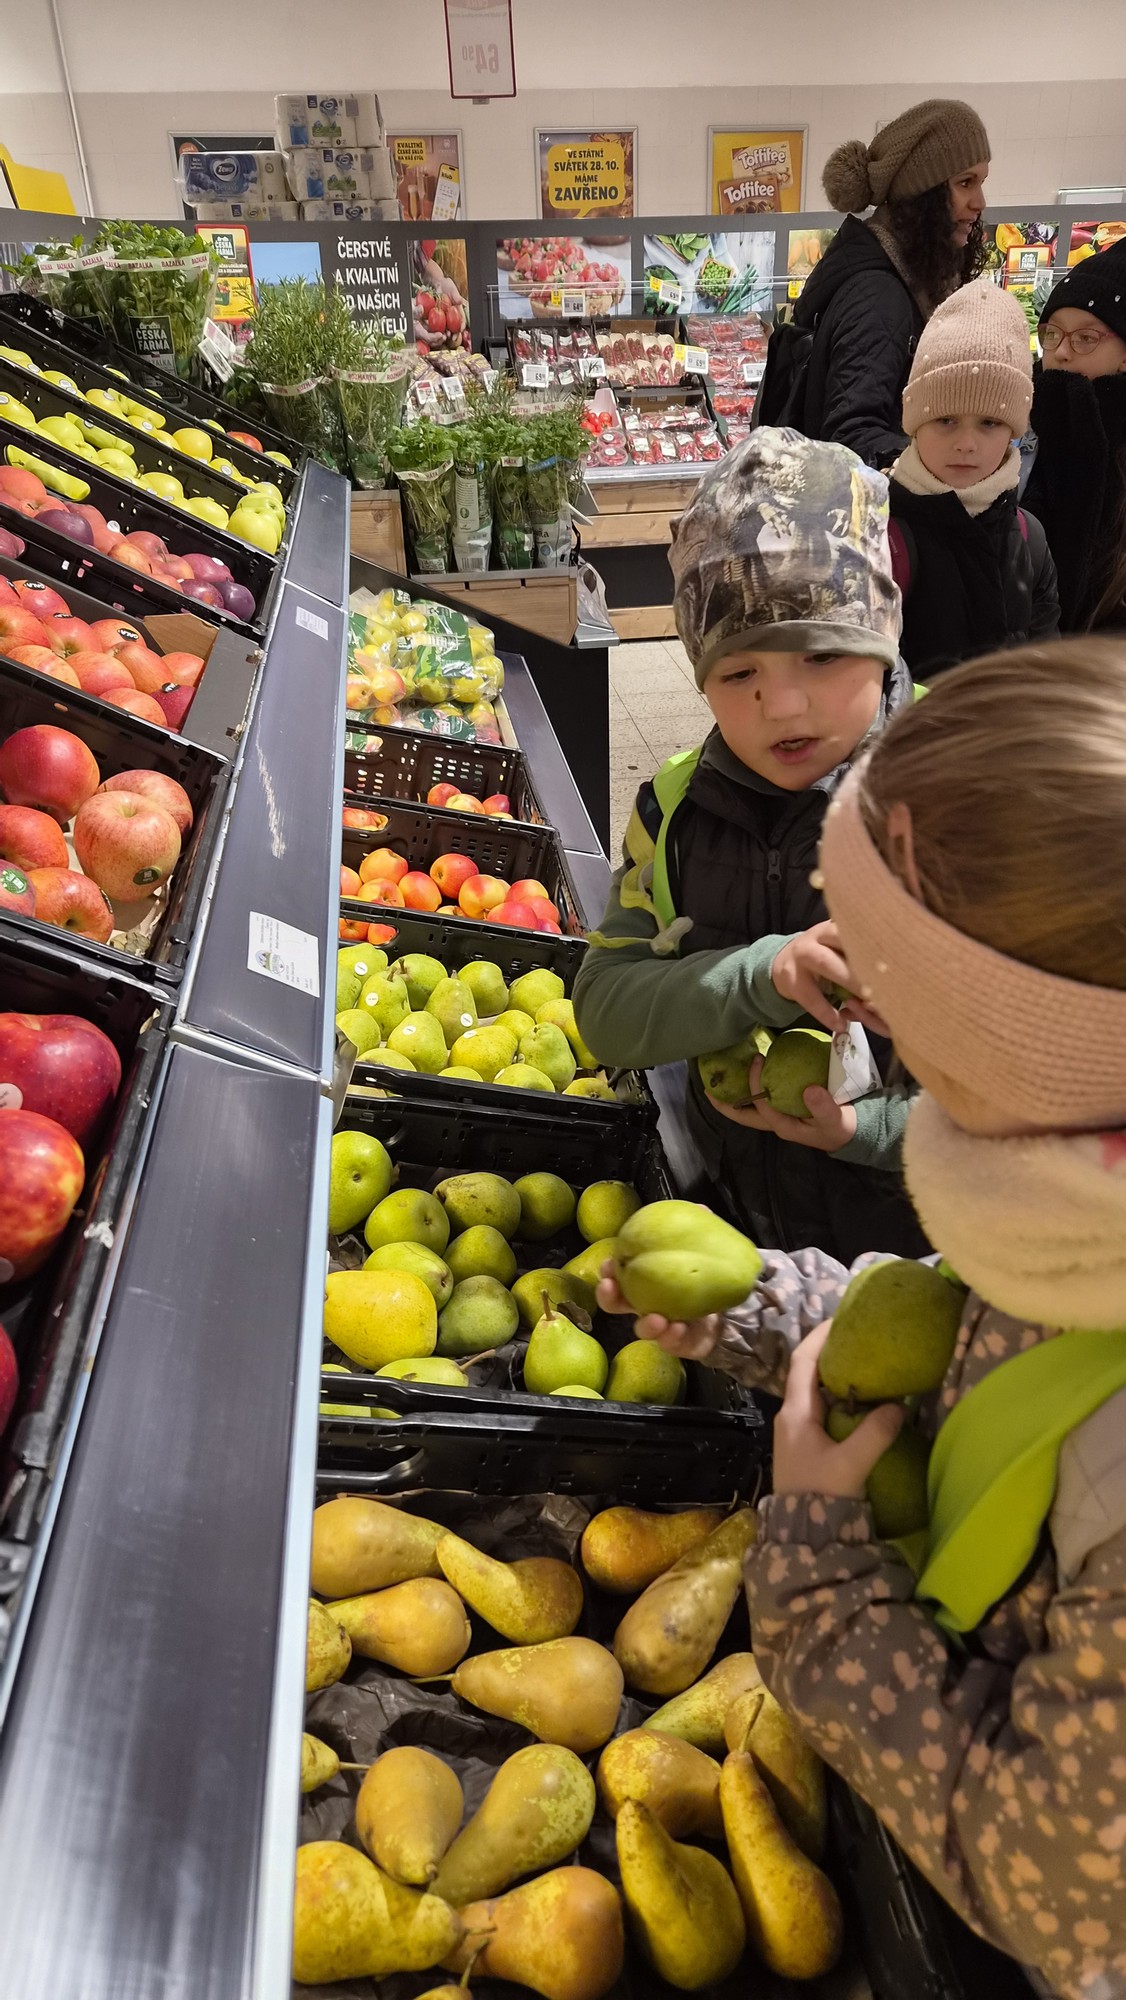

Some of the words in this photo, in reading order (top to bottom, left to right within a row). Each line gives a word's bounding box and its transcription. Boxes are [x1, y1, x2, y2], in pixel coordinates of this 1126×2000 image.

[568, 150, 577, 158] VE
[578, 148, 604, 158] STÁTNÍ
[738, 147, 786, 169] Toffifee
[554, 159, 588, 171] SVÁTEK
[590, 161, 604, 171] 28.
[606, 160, 619, 170] 10.
[574, 173, 598, 183] MÁME
[554, 183, 619, 201] ZAVŘENO
[724, 181, 775, 204] Toffifee
[337, 236, 392, 258] ČERSTVÉ
[128, 261, 153, 269] BAZALKA
[335, 268, 344, 285] A
[345, 262, 399, 285] KVALITNÍ
[357, 288, 401, 311] NAŠICH
[138, 340, 170, 351] FARMA
